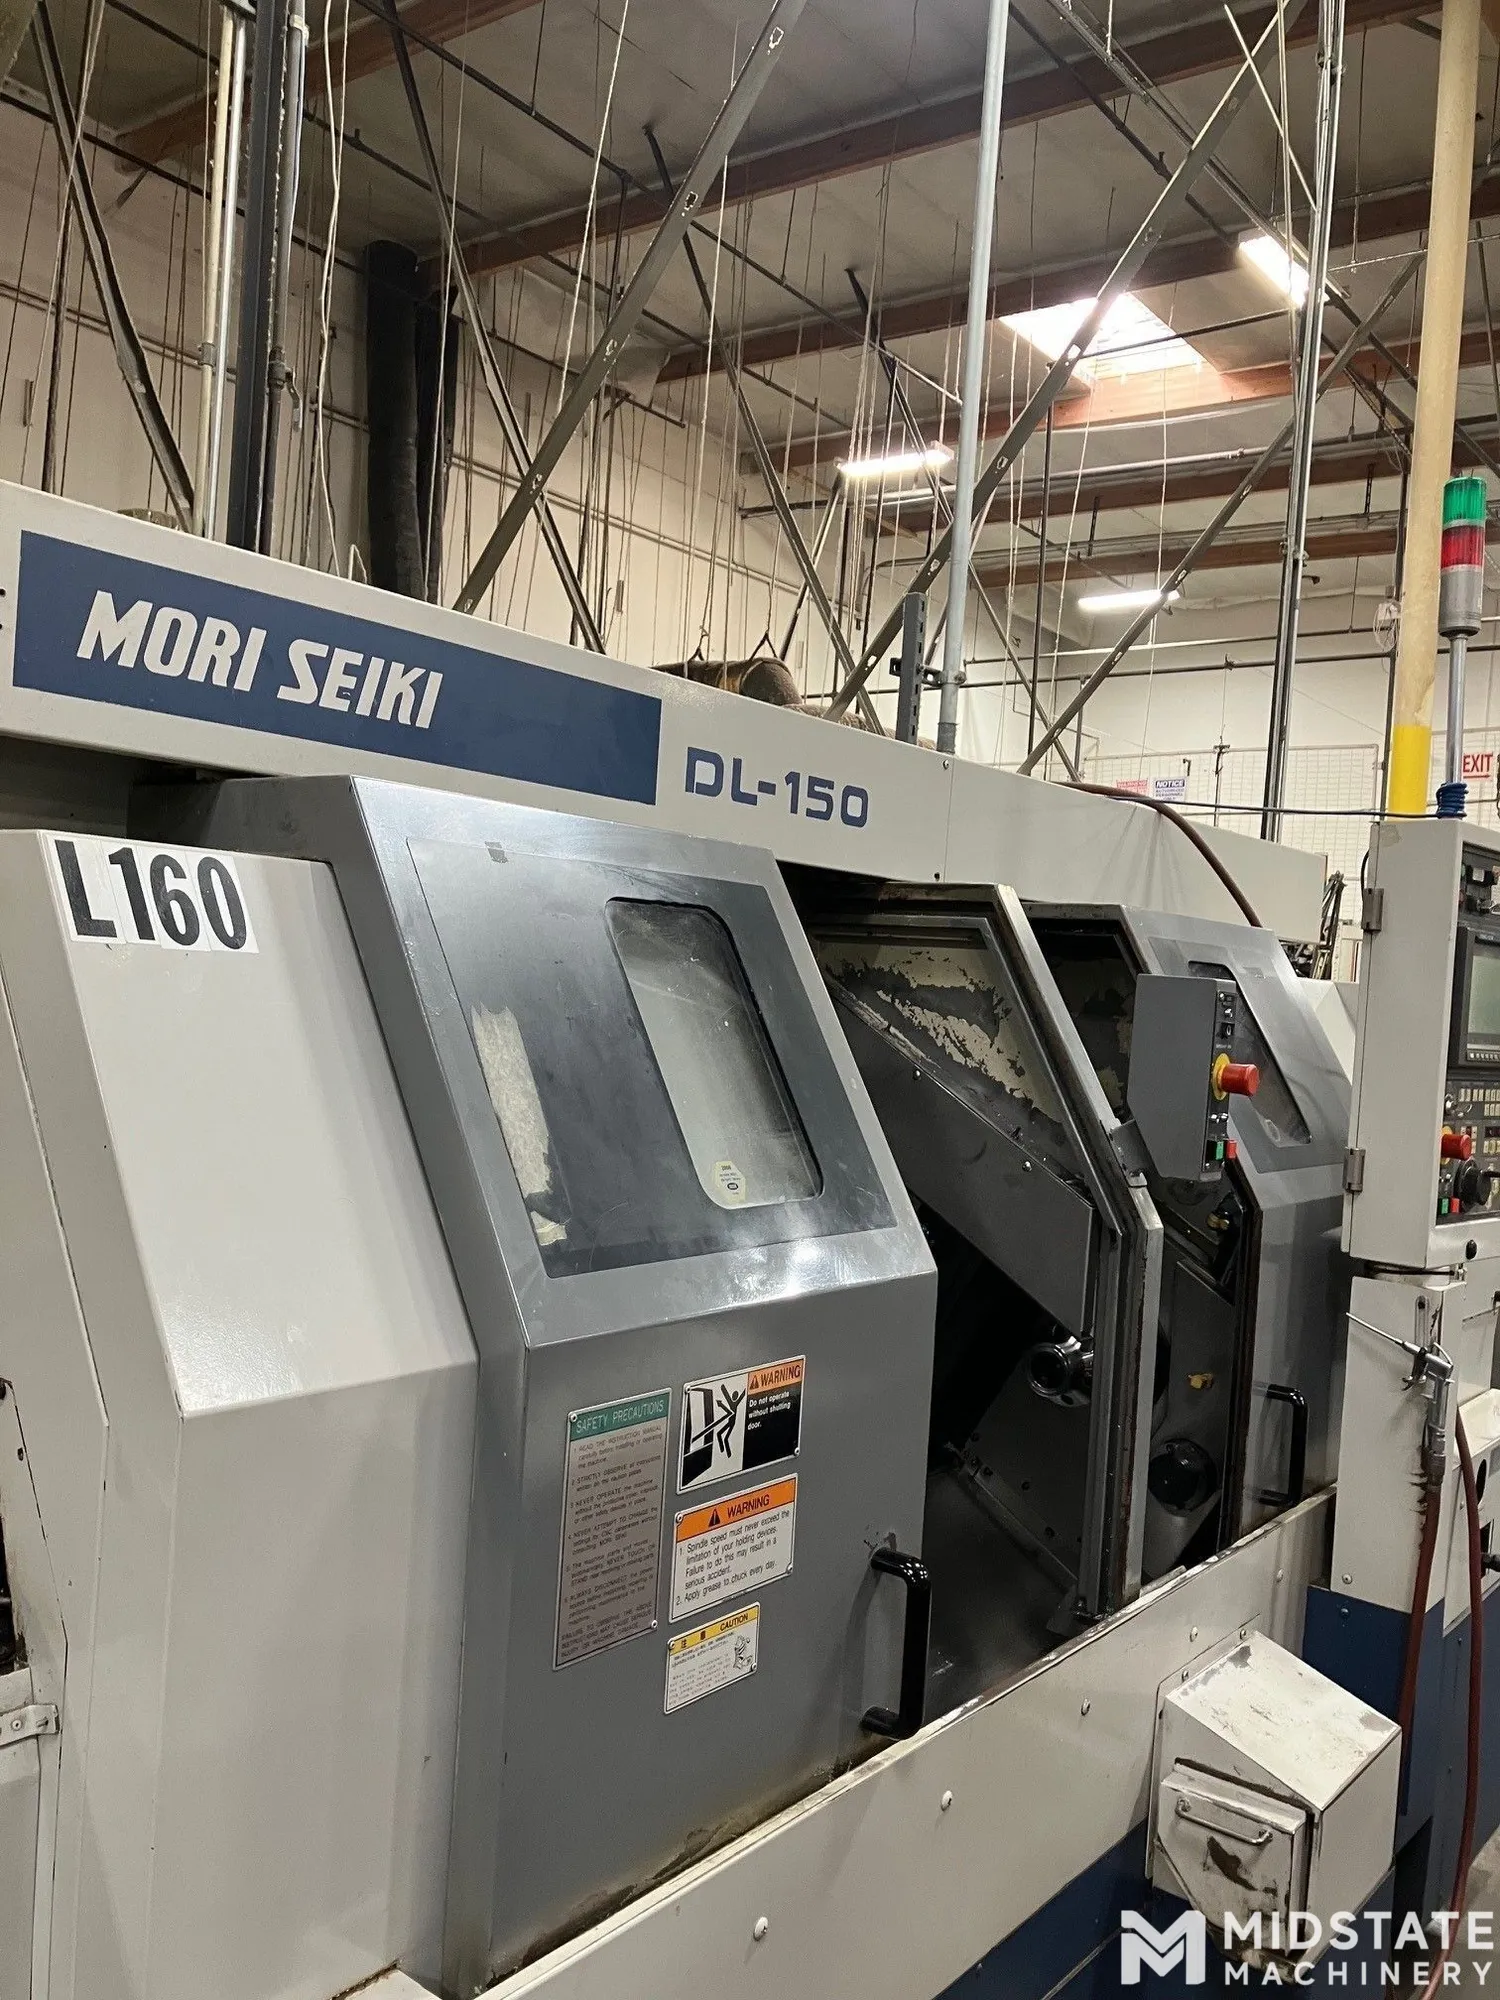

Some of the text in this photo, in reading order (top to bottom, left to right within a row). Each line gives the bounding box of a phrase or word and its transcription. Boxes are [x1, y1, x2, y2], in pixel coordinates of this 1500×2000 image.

[76, 589, 444, 730] MORI SEIKI
[1463, 753, 1493, 772] EXIT
[685, 746, 869, 829] DL-150
[1157, 780, 1184, 788] NOTICE
[52, 838, 250, 952] L160
[761, 1365, 801, 1387] WARNING
[748, 1402, 791, 1418] without shutting
[749, 1391, 790, 1408] Do not operate
[576, 1400, 663, 1434] SAFETY PRECAUTIONS
[747, 1421, 762, 1430] door.
[727, 1494, 770, 1518] WARNING
[687, 1538, 708, 1553] Spindle
[710, 1531, 728, 1545] speed
[729, 1526, 743, 1537] must
[744, 1521, 759, 1531] never
[761, 1513, 780, 1526] exceed
[781, 1510, 790, 1518] the
[685, 1537, 777, 1577] Failure to do this may result in a
[686, 1549, 711, 1565] limitation
[713, 1544, 720, 1555] of
[721, 1541, 734, 1554] your
[735, 1533, 755, 1549] holding
[684, 1589, 699, 1602] Apply
[702, 1581, 722, 1596] grease
[723, 1577, 729, 1586] to
[731, 1568, 748, 1584] chuck
[749, 1563, 764, 1577] every
[685, 1575, 705, 1590] serious
[719, 1612, 749, 1632] CAUTION
